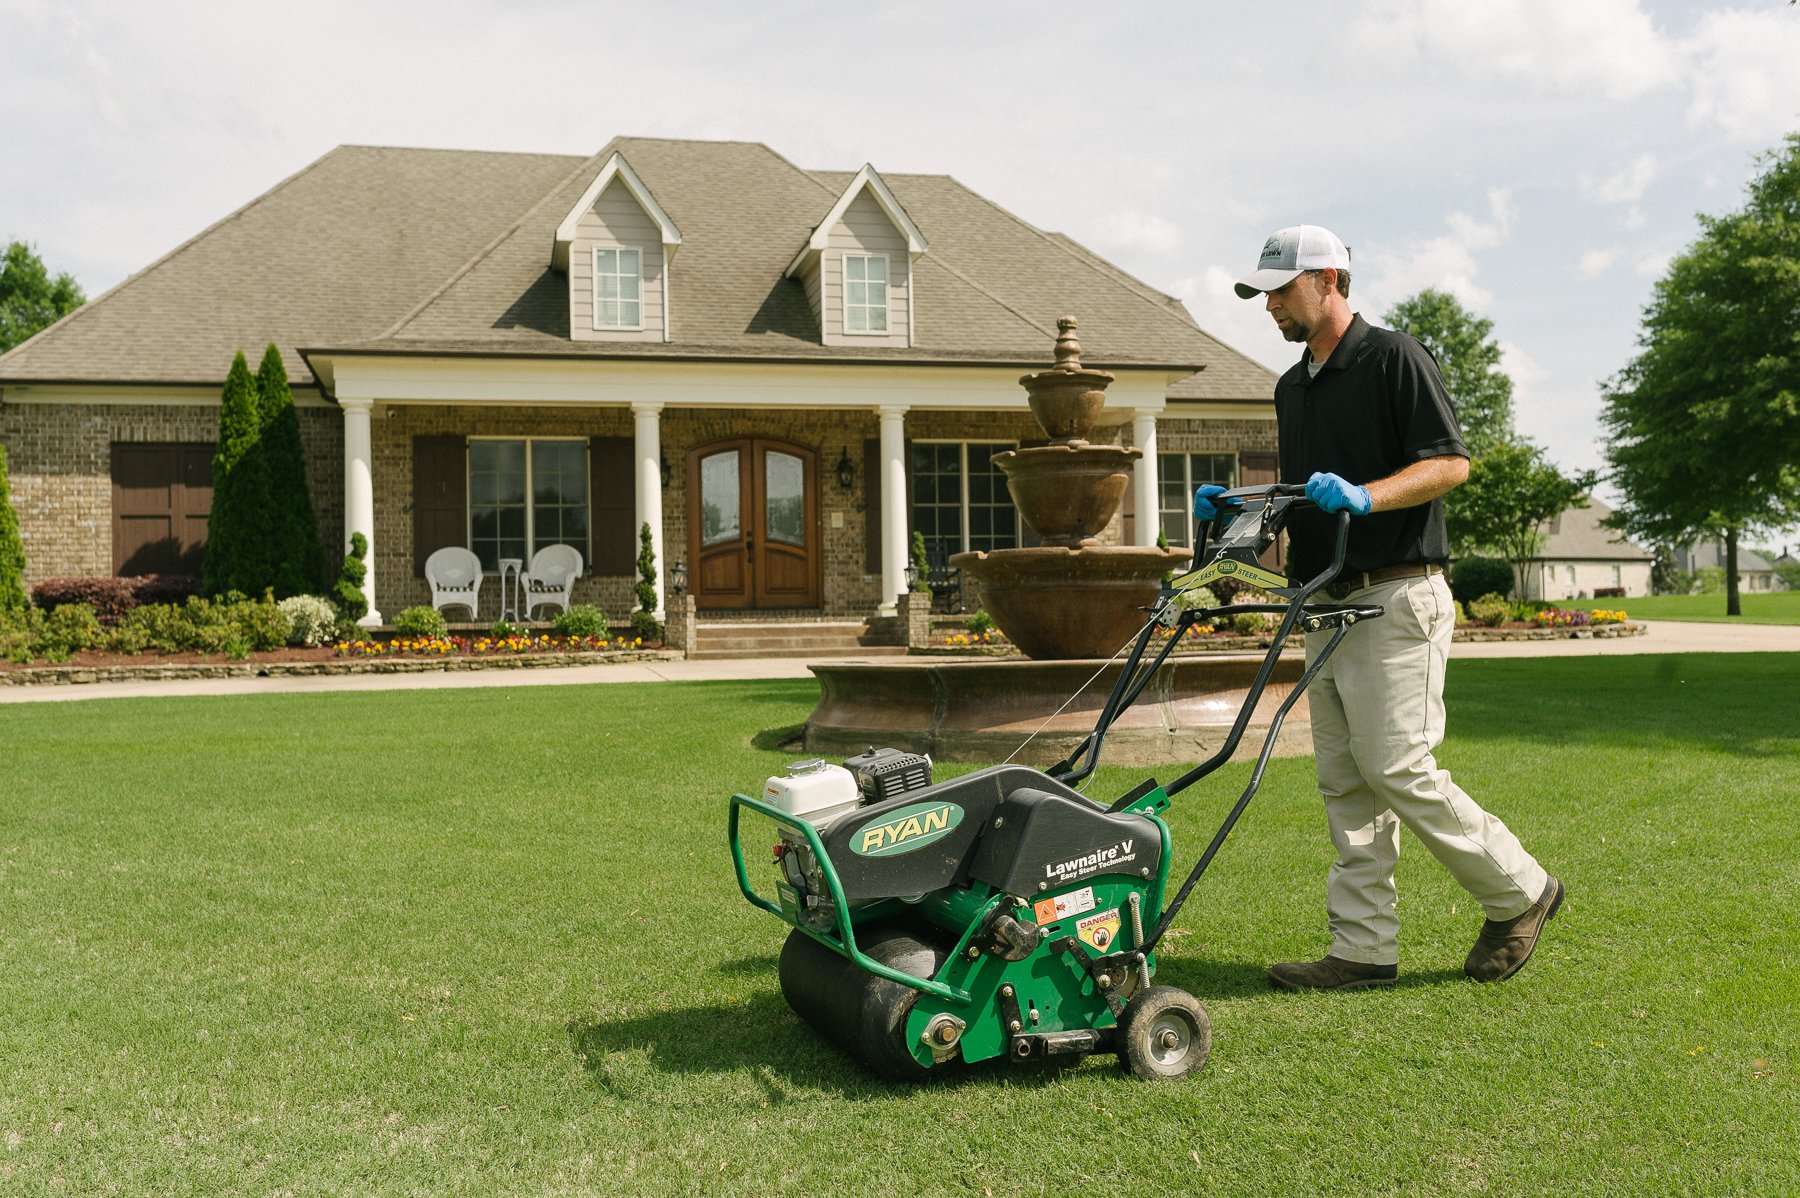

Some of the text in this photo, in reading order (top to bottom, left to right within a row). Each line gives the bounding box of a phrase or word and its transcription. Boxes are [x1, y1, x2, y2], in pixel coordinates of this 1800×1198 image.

[1200, 569, 1216, 580] EASY
[1238, 569, 1258, 580] STEER
[861, 806, 951, 853] RYAN
[1046, 839, 1134, 878] Lawnaire V
[1060, 852, 1136, 881] Easy Steer Technology
[1080, 911, 1118, 929] DANGER
